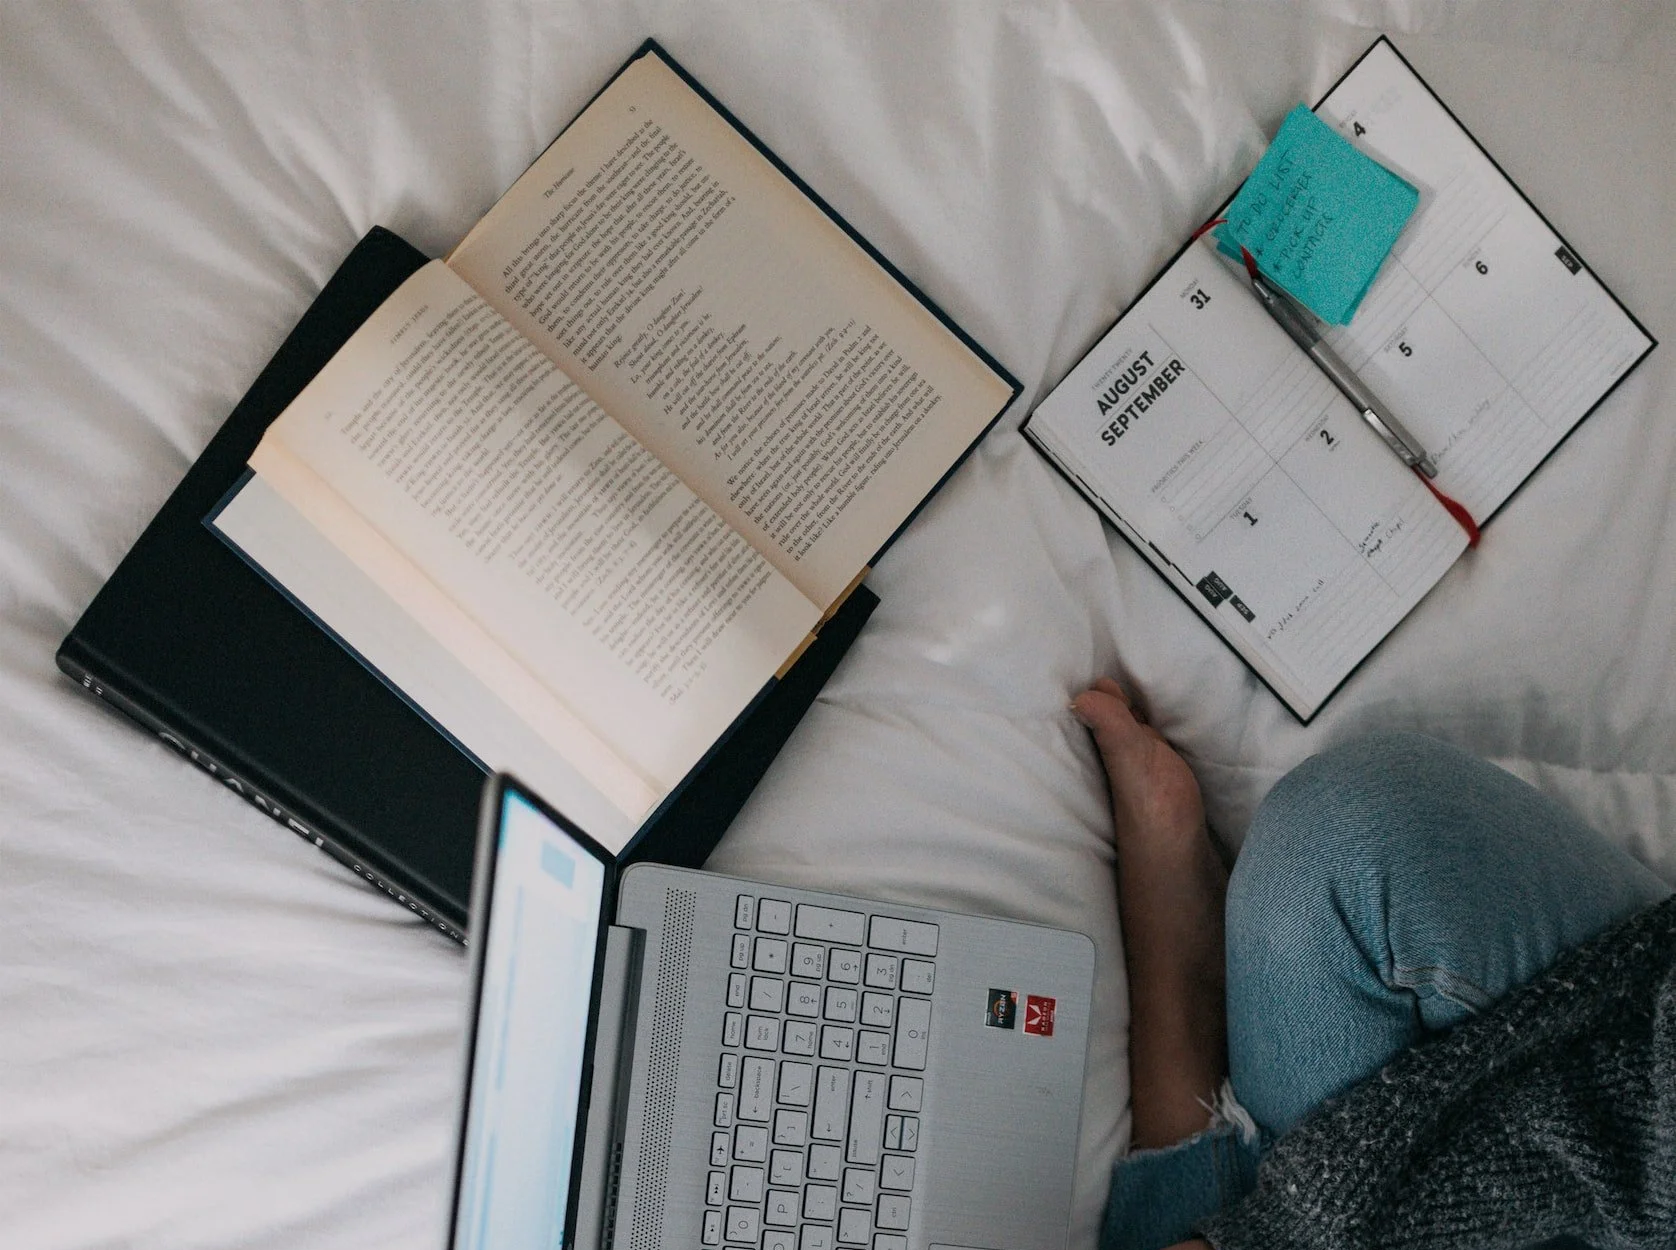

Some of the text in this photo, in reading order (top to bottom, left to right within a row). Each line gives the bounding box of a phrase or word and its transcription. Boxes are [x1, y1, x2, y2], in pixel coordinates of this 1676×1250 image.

[1349, 121, 1367, 138] 4
[1235, 149, 1301, 236] TO DO LIST
[1275, 196, 1322, 261] PICK UP
[503, 192, 597, 294] third great storm, the hurricane from
[1473, 259, 1490, 276] 6
[1178, 277, 1200, 299] MONDAY
[1188, 287, 1211, 310] 31
[1397, 341, 1414, 358] 5
[1091, 350, 1158, 415] AUGUST
[1096, 357, 1189, 447] SEPTEMBER
[1318, 428, 1334, 445] 2
[725, 426, 780, 487] We notice the echoes
[1149, 438, 1204, 494] PRIORITIES THIS WEEK
[1229, 496, 1253, 520] TUESDAY
[1242, 509, 1259, 526] 1
[803, 956, 814, 965] 9
[840, 962, 851, 970] 6
[876, 967, 887, 975] 3
[799, 995, 809, 1004] 8
[836, 1000, 846, 1008] 5
[873, 1005, 883, 1014] 2
[795, 1034, 806, 1042] 7
[907, 1029, 918, 1038] 0
[832, 1038, 842, 1047] 4
[724, 1061, 732, 1080] delete
[753, 1065, 763, 1098] backspace
[777, 1203, 788, 1213] P
[738, 1219, 748, 1229] 0
[811, 1238, 822, 1247] L
